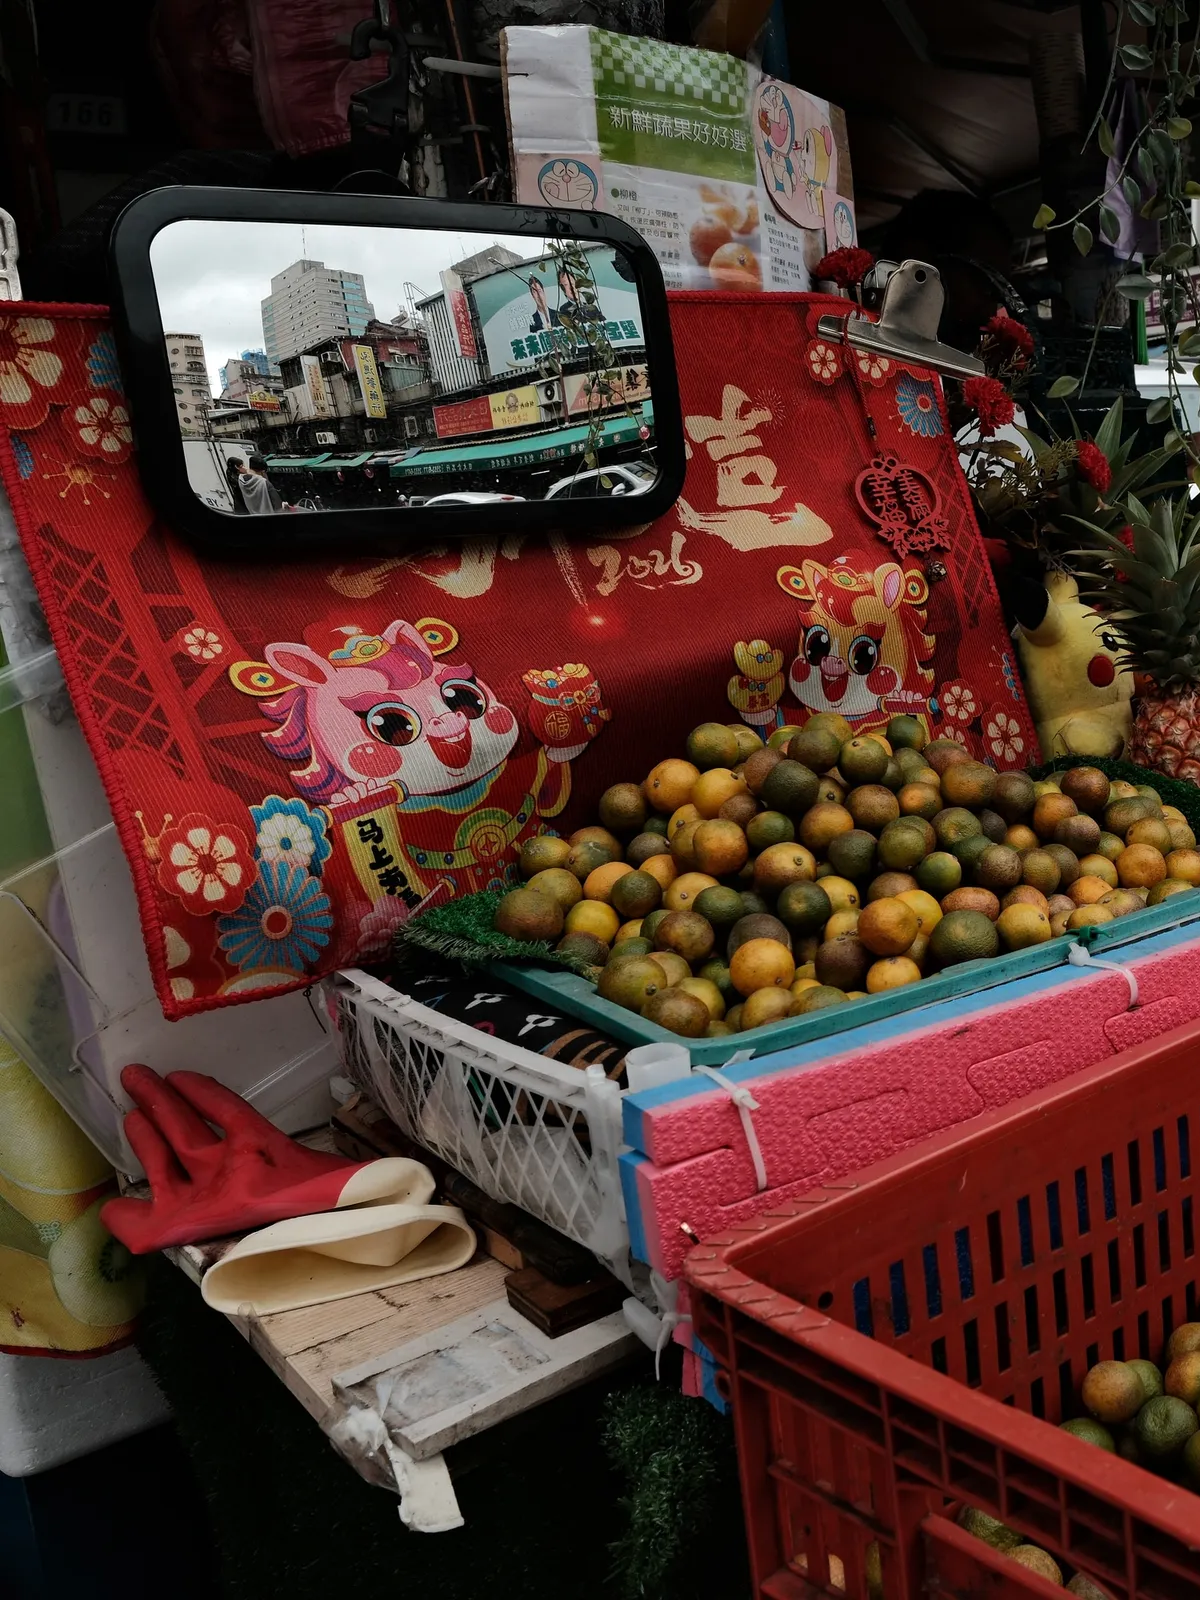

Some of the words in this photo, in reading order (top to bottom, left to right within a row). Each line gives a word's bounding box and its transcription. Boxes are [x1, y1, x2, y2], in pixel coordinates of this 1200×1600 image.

[608, 104, 747, 153] 新鮮蔬果好好選
[588, 531, 704, 598] 2026
[545, 711, 571, 739] 福
